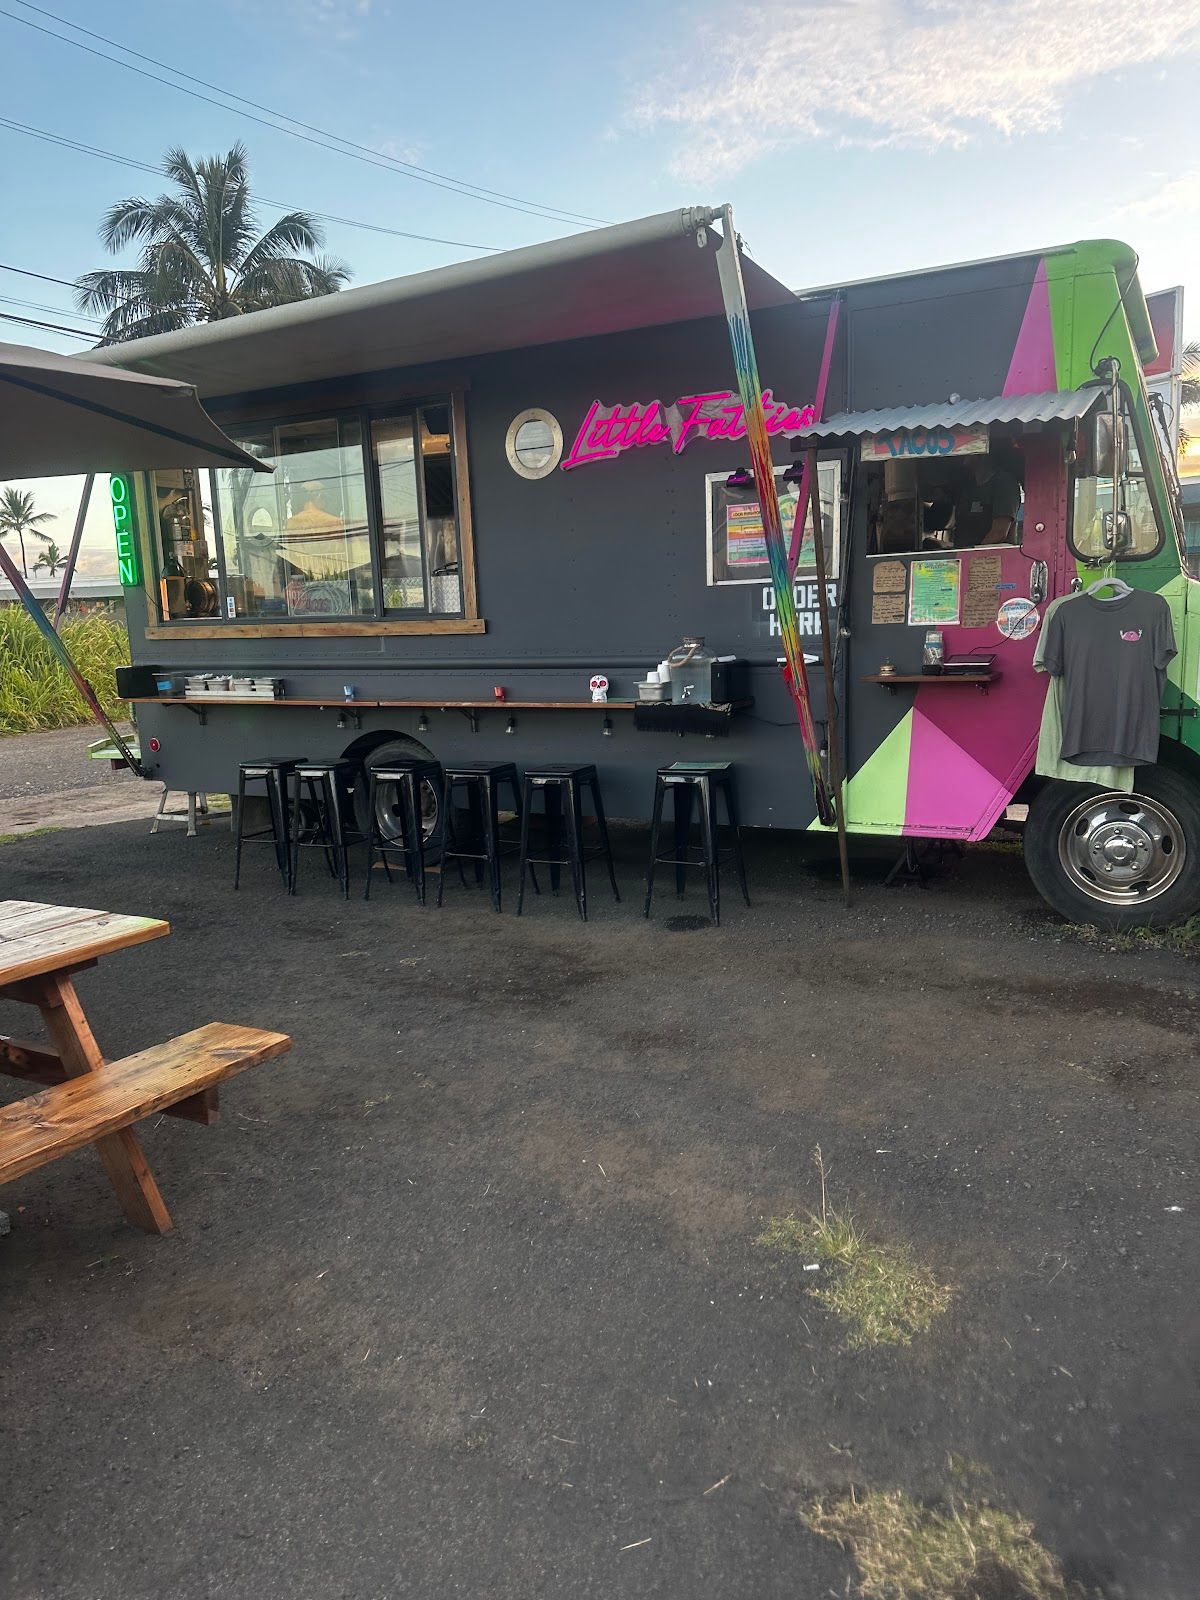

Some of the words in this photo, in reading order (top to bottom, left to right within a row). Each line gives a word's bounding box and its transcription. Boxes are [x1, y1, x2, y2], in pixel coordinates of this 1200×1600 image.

[561, 400, 670, 469] Little
[875, 429, 955, 457] TACOS
[110, 476, 133, 584] OPEN
[762, 583, 838, 610] ODER
[769, 611, 823, 637] HRE
